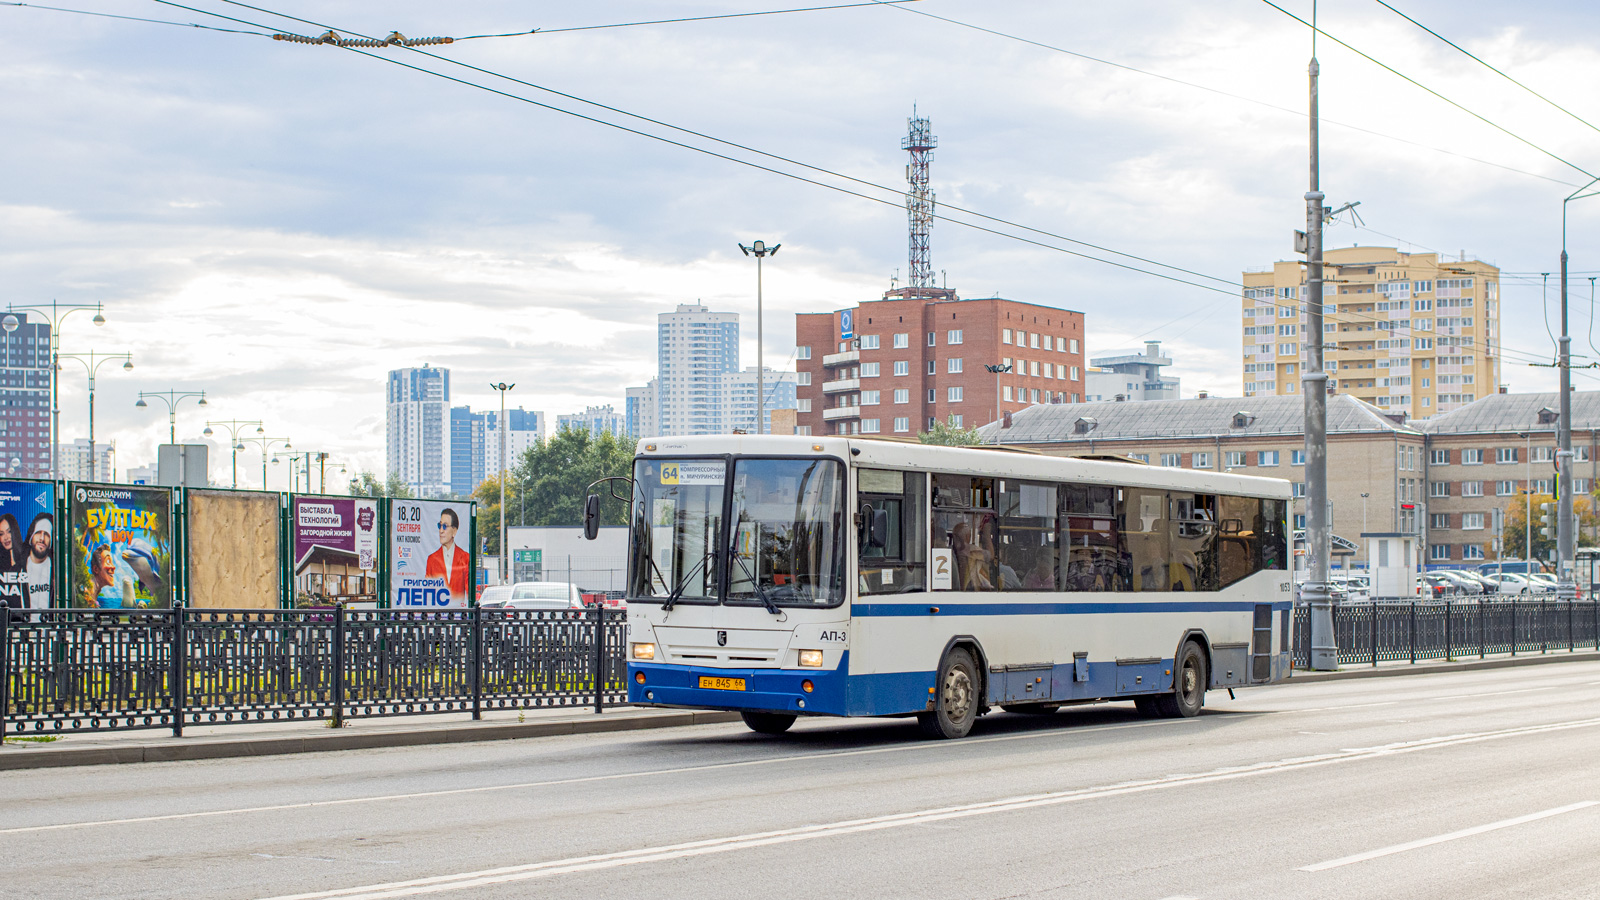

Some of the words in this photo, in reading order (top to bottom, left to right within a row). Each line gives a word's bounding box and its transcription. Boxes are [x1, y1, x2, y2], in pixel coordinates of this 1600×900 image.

[662, 467, 678, 479] 64
[88, 490, 131, 499] ОКЕАНАРИУМ
[87, 508, 157, 530] БУЛТЫХ
[397, 506, 408, 522] 18,
[411, 507, 421, 521] 20
[301, 516, 339, 524] ТЕХНОЛОГИЙ
[300, 529, 333, 537] ЗАГОРОДНОЙ
[397, 523, 421, 533] СЕНТЯБРЯ
[111, 530, 134, 545] ШОУ
[403, 578, 444, 586] ГРИГОРИЙ
[1280, 583, 1290, 592] 1053
[397, 588, 450, 606] ЛЕПС
[820, 631, 846, 641] АП-3
[715, 679, 731, 688] 845
